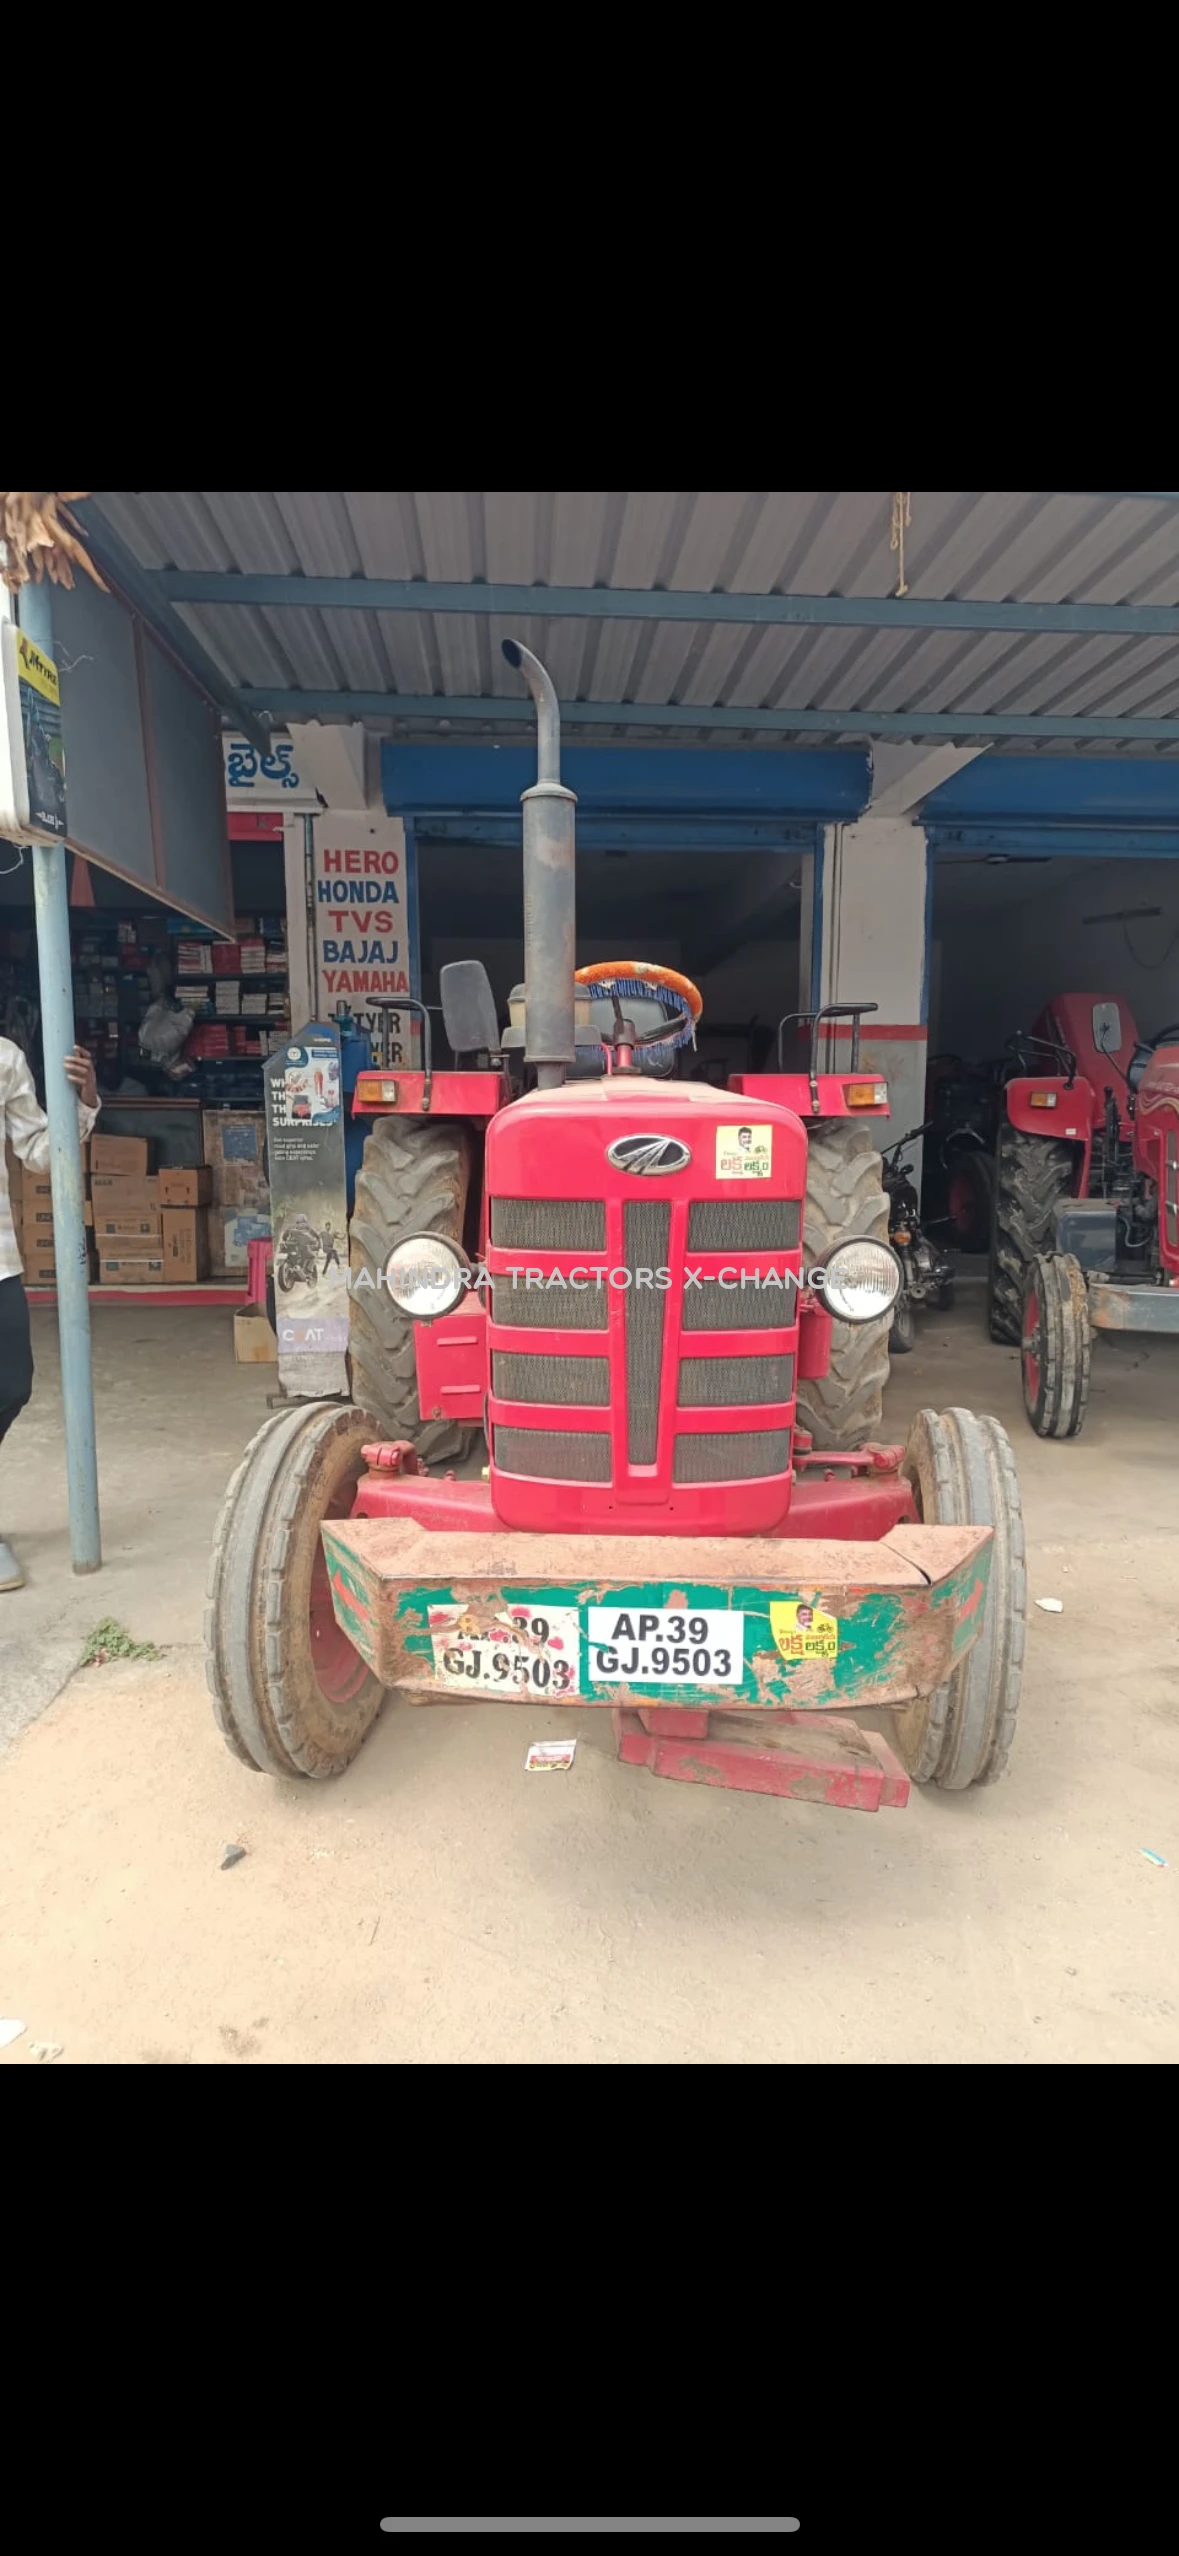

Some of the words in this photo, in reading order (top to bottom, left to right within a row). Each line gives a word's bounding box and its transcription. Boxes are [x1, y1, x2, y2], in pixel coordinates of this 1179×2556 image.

[323, 849, 399, 874] HERO
[318, 880, 399, 904] HONDA
[328, 910, 394, 933] TVS
[323, 940, 399, 963] BAJAJ
[322, 969, 409, 993] YAMAHA
[611, 1613, 709, 1645] AP.39
[443, 1647, 571, 1690] GJ.9503
[596, 1645, 732, 1677] GJ.9503
